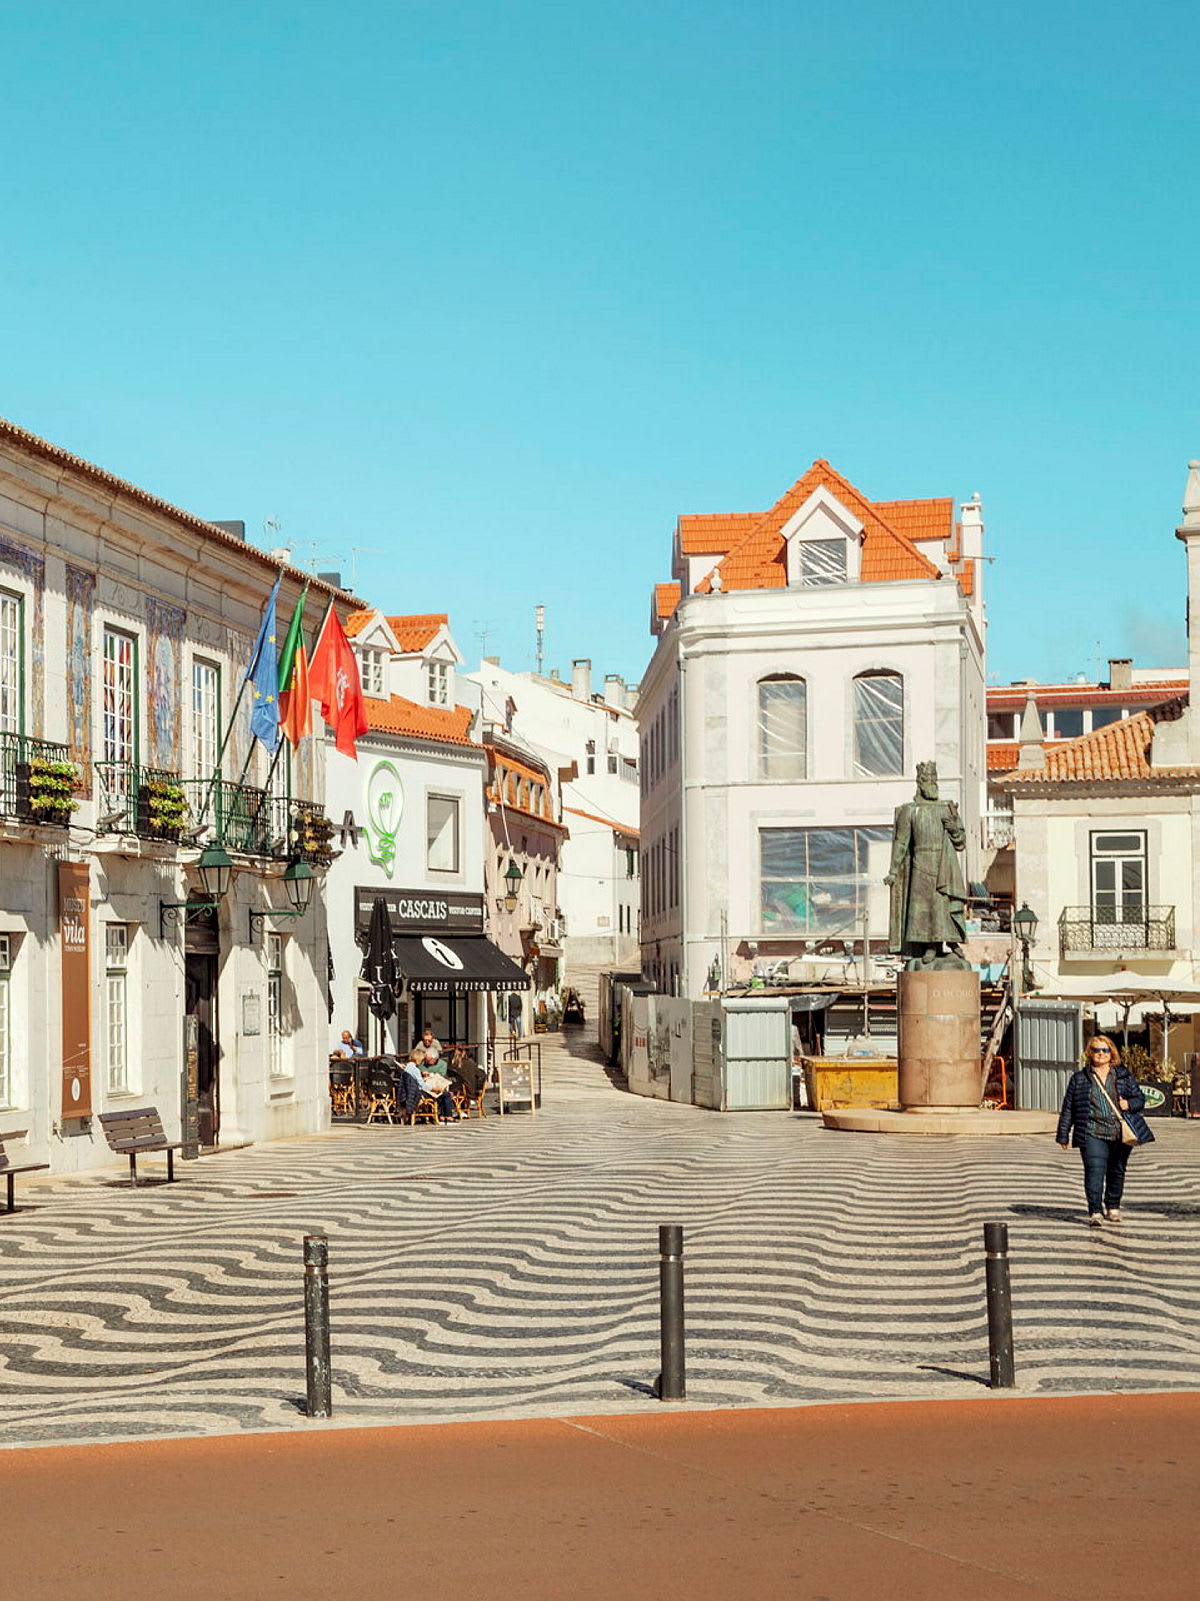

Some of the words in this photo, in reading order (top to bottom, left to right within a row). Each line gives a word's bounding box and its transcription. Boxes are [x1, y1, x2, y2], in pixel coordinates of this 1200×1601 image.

[63, 898, 86, 912] MUSEU
[398, 899, 448, 919] CASCAIS
[63, 916, 86, 944] vila
[410, 982, 448, 990] CASCAIS
[455, 981, 490, 990] VISITOR
[496, 981, 528, 990] CENTER
